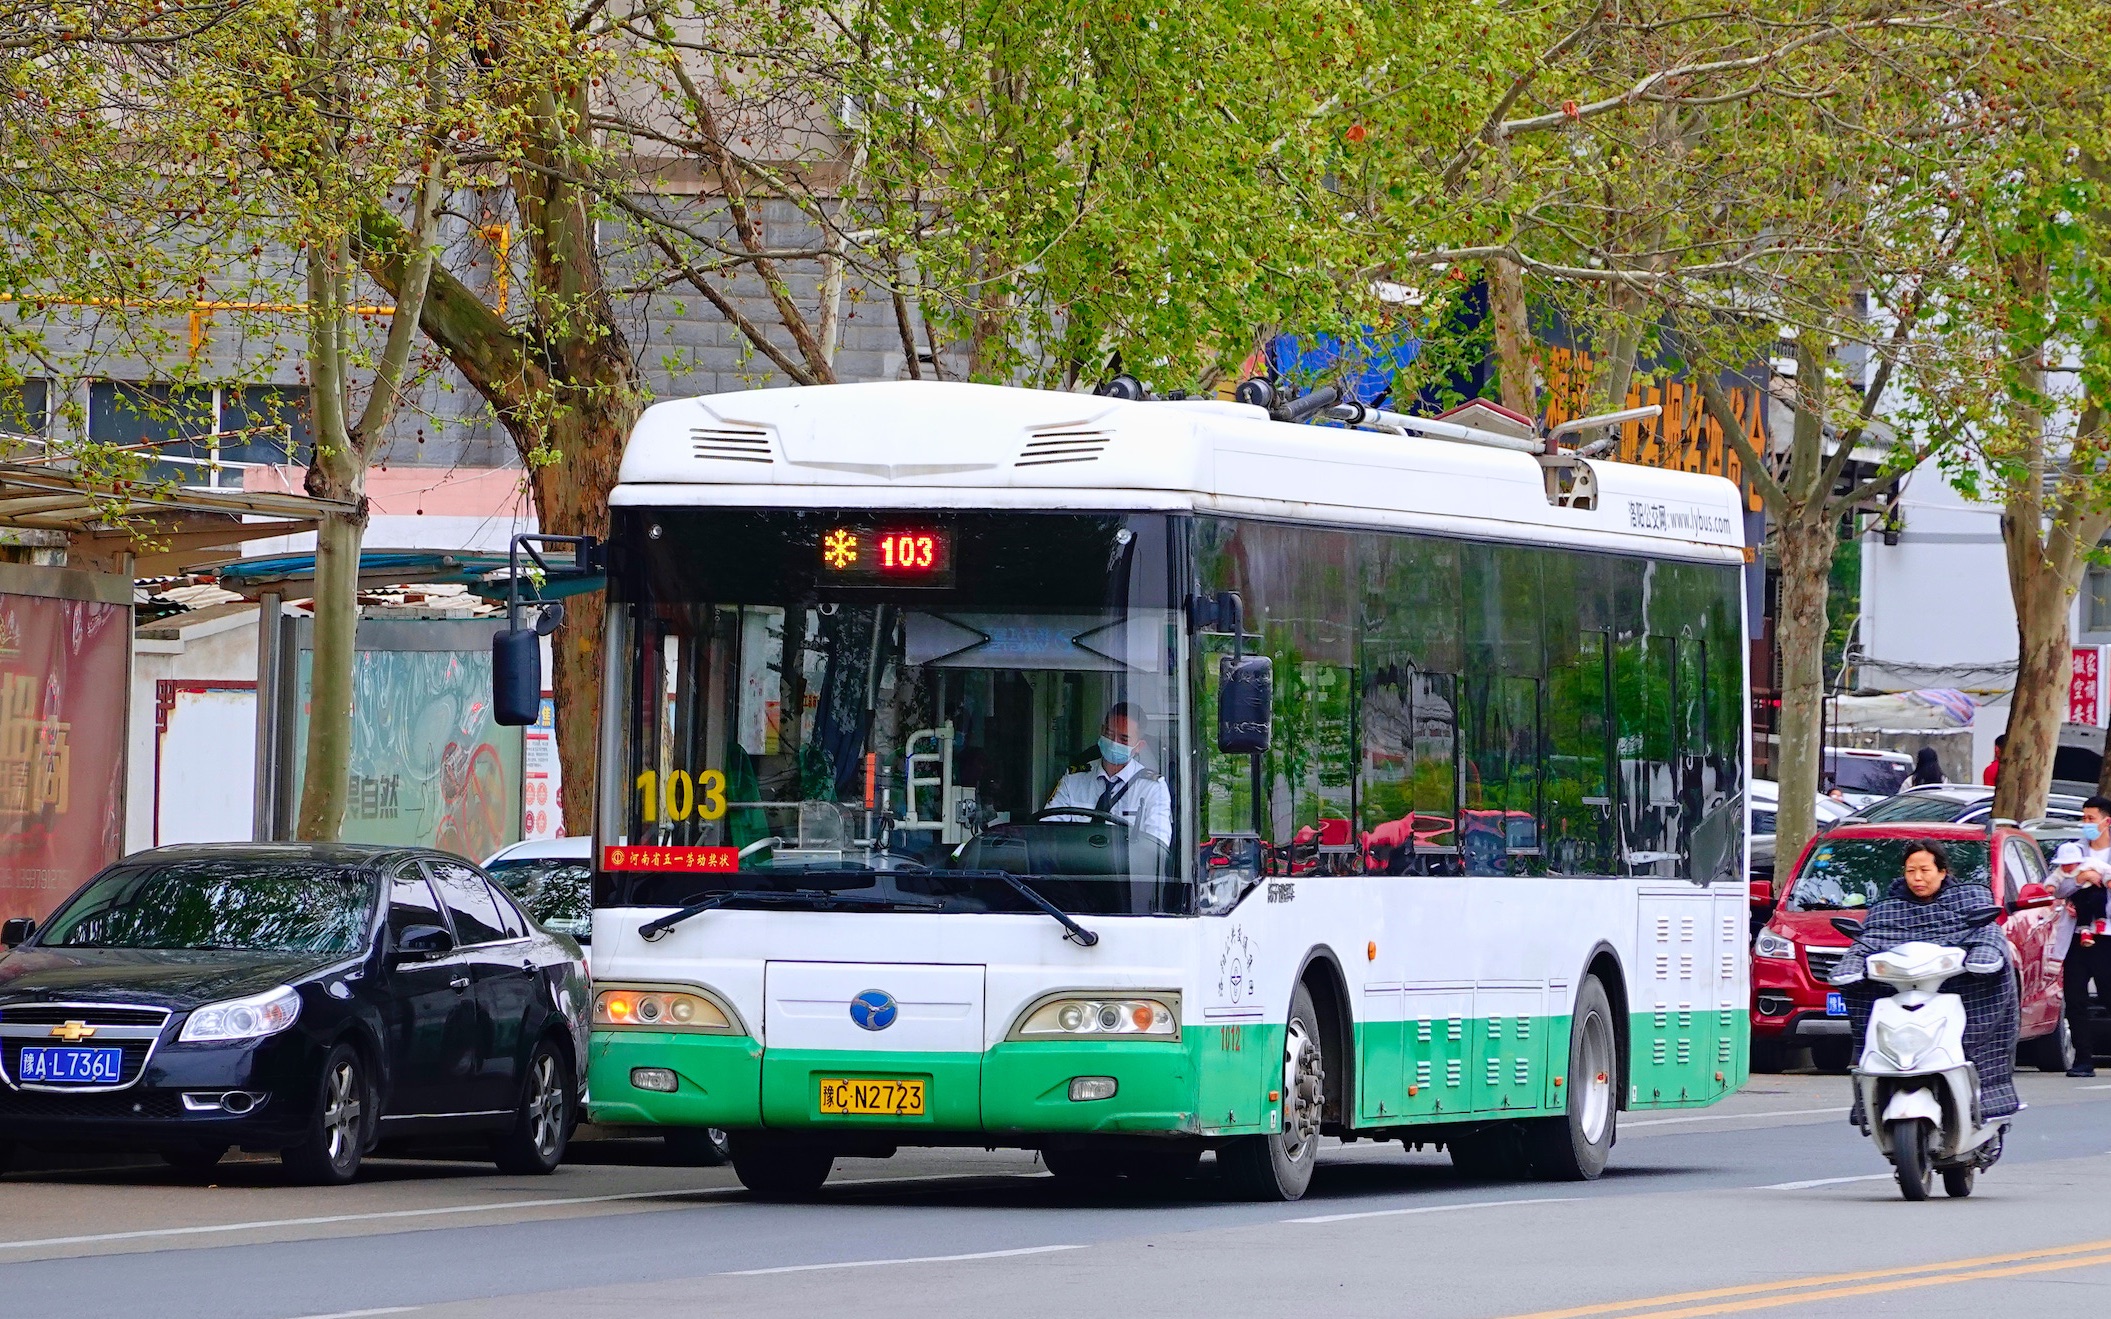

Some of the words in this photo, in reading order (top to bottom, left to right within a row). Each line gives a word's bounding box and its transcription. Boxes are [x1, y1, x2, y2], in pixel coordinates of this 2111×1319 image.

[882, 537, 933, 566] 103
[636, 769, 727, 822] 103
[629, 852, 731, 868] 河南省五一劳动奖状
[1220, 1025, 1241, 1052] 1012
